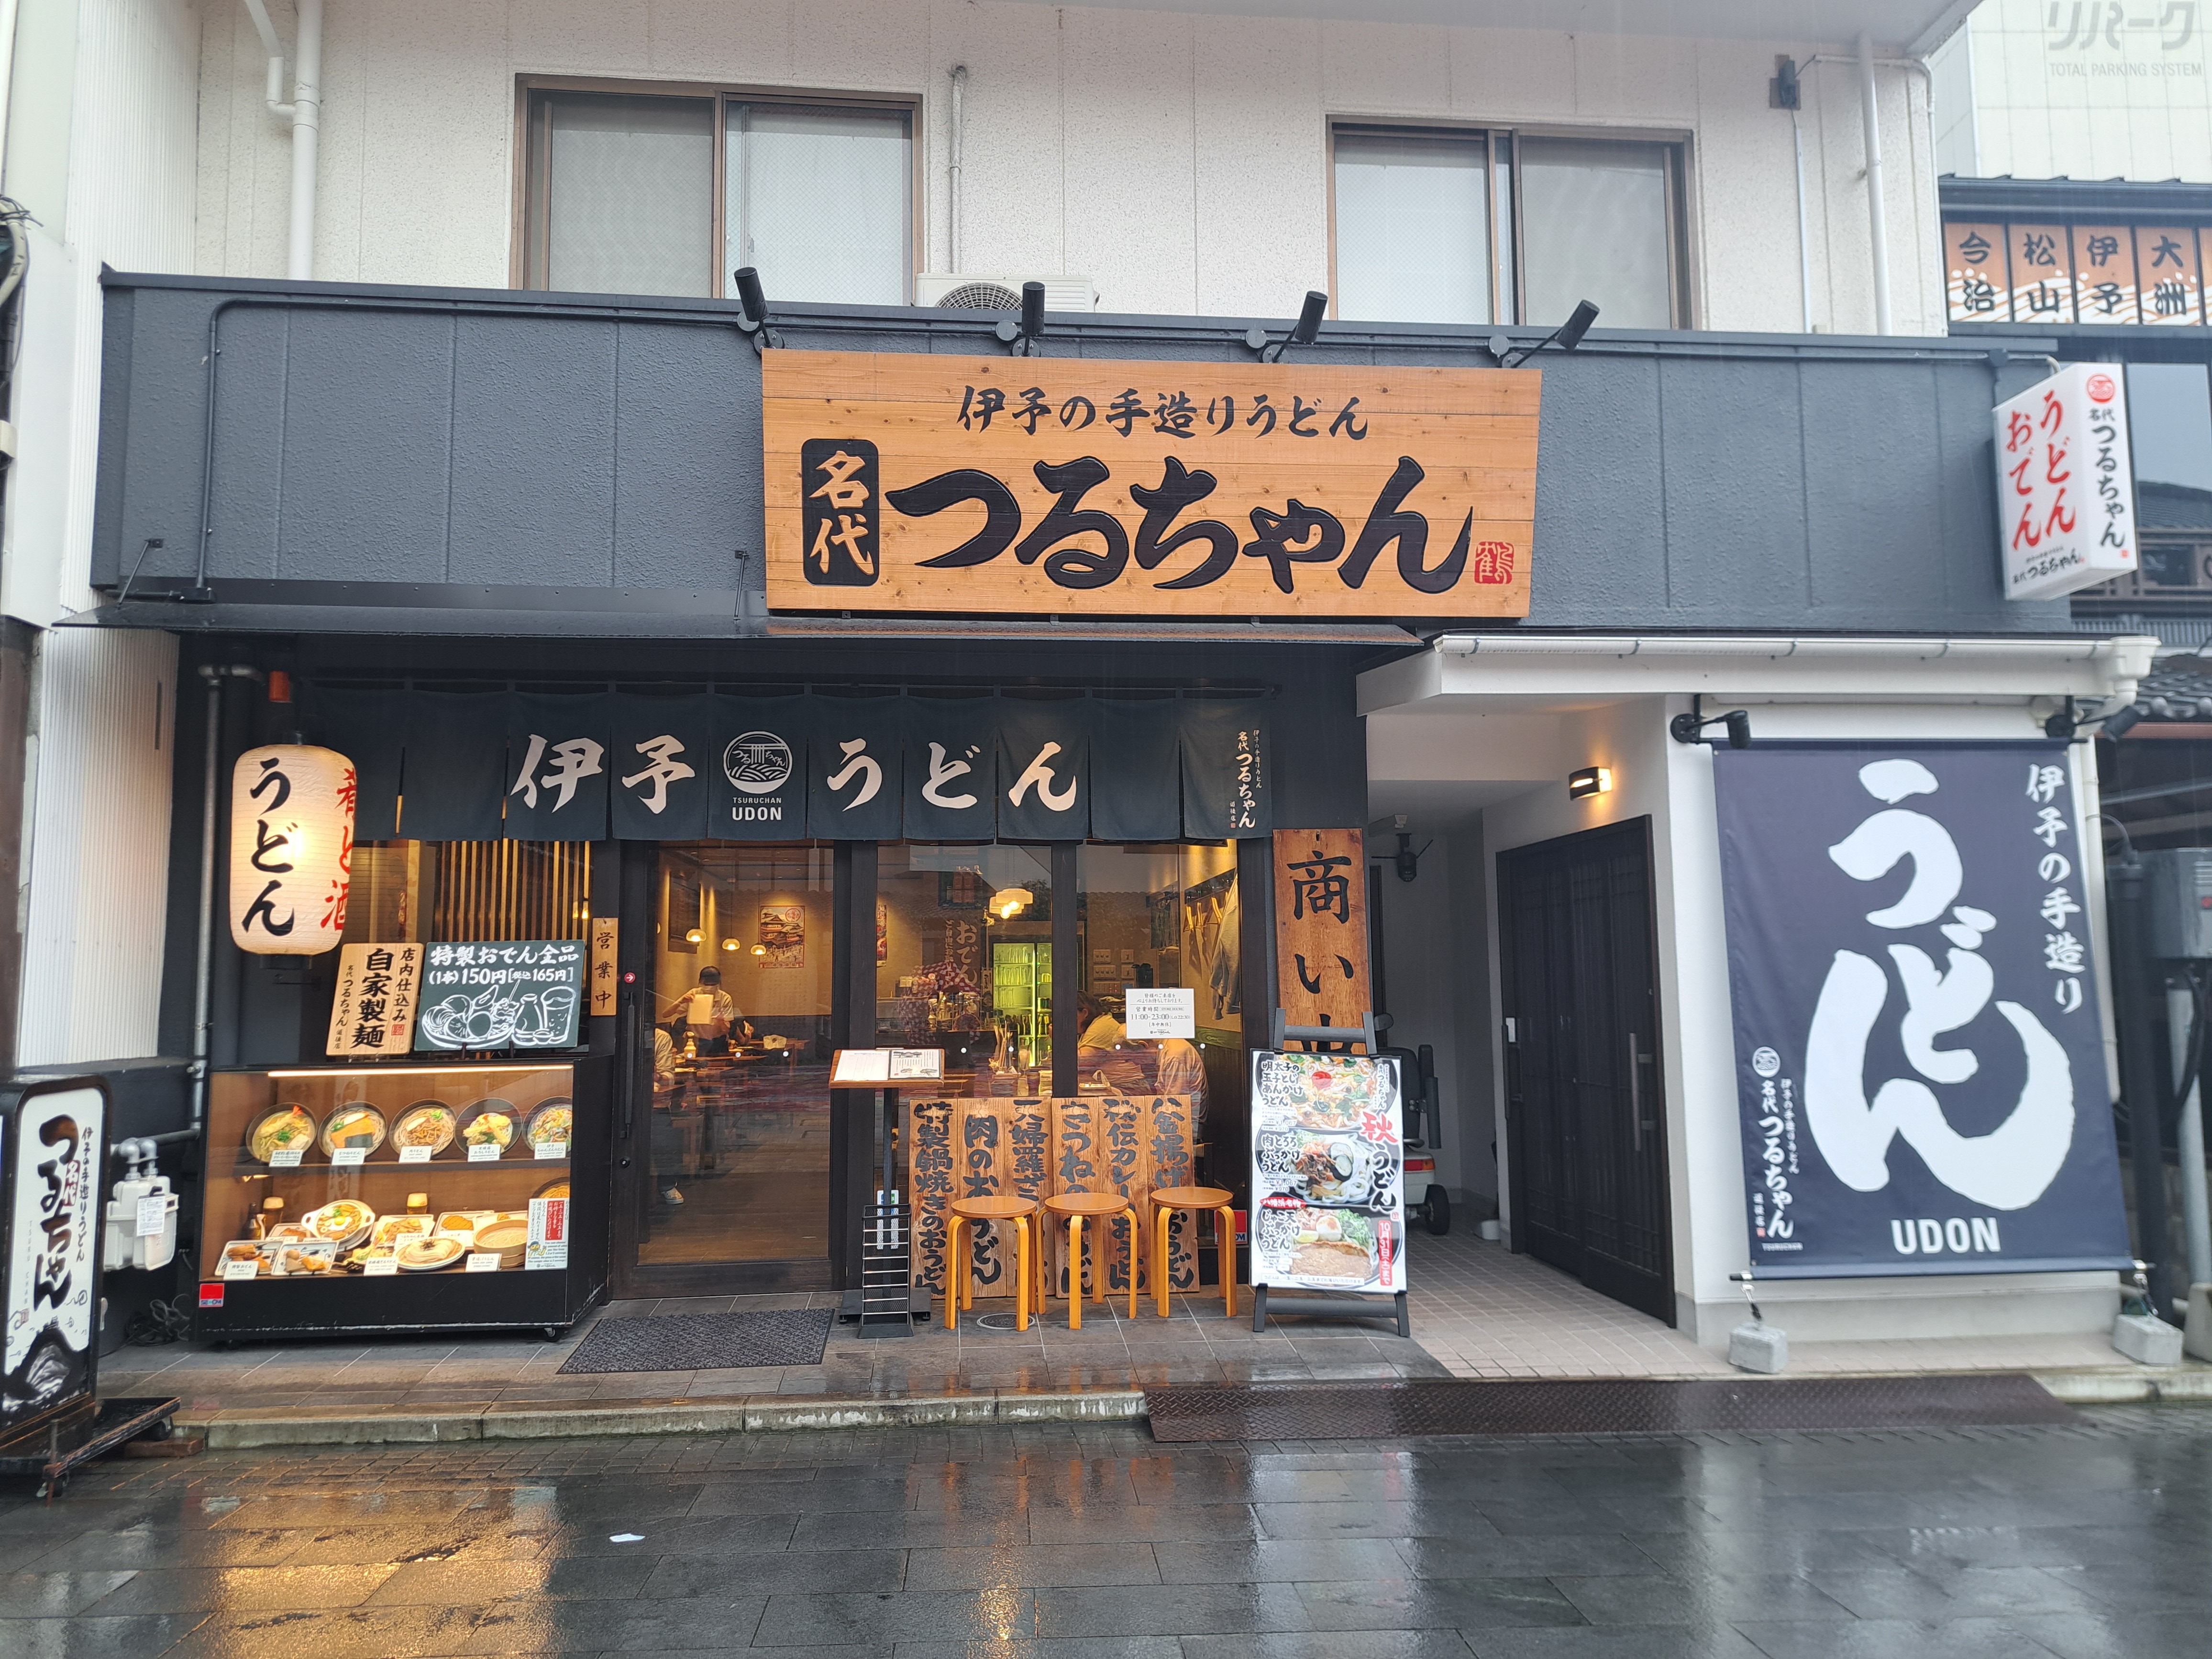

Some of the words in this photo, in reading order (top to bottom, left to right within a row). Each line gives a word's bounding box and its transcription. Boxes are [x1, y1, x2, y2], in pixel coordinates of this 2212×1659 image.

[2050, 63, 2087, 77] TOTAL
[2091, 63, 2146, 77] PARKING
[2152, 63, 2202, 77] SYSTEM
[1959, 231, 1996, 311] 今治
[2024, 232, 2059, 313] 松山
[2086, 234, 2123, 314] 伊予
[2152, 235, 2187, 315] 大洲
[959, 385, 1368, 441] 伊予の手造りうどん
[2006, 410, 2042, 552] おでん
[2040, 388, 2077, 535] うどん
[2091, 425, 2125, 548] つるちゃん
[809, 450, 876, 577] 名代
[885, 456, 1472, 595] つるちゃん
[827, 738, 1077, 812] うどん
[1235, 753, 1256, 829] つるちゃん
[241, 757, 299, 937] うどん
[732, 807, 782, 821] UDON
[2025, 764, 2086, 1015] 伊予の手造り
[392, 947, 416, 1022] 店内仕込み
[430, 944, 579, 967] 特製おでん全品
[595, 931, 614, 1009] 営業中
[955, 920, 978, 985] おでん
[1803, 758, 2077, 1211] うどん
[336, 979, 354, 1027] つるちゃん
[349, 948, 395, 1049] 自家製麺
[1262, 1061, 1300, 1072] 明太子の
[1262, 1073, 1299, 1084] 玉子とじ
[1262, 1084, 1304, 1095] あんかけ
[1262, 1094, 1289, 1106] うどん
[1262, 1135, 1297, 1148] 肉とろろ
[1262, 1148, 1301, 1161] ぶっかけ
[1360, 1111, 1398, 1143] 秋
[76, 1126, 94, 1263] 伊予の手造りうどん
[1262, 1161, 1290, 1172] うどん
[1372, 1143, 1397, 1212] うどん
[1758, 1116, 1793, 1239] つるちゃん
[33, 1114, 79, 1312] つるちゃん
[1262, 1210, 1297, 1223] じゃこ天
[1262, 1224, 1301, 1236] ぶっかけ
[1262, 1236, 1290, 1250] うどん
[1891, 1217, 2002, 1254] UDON
